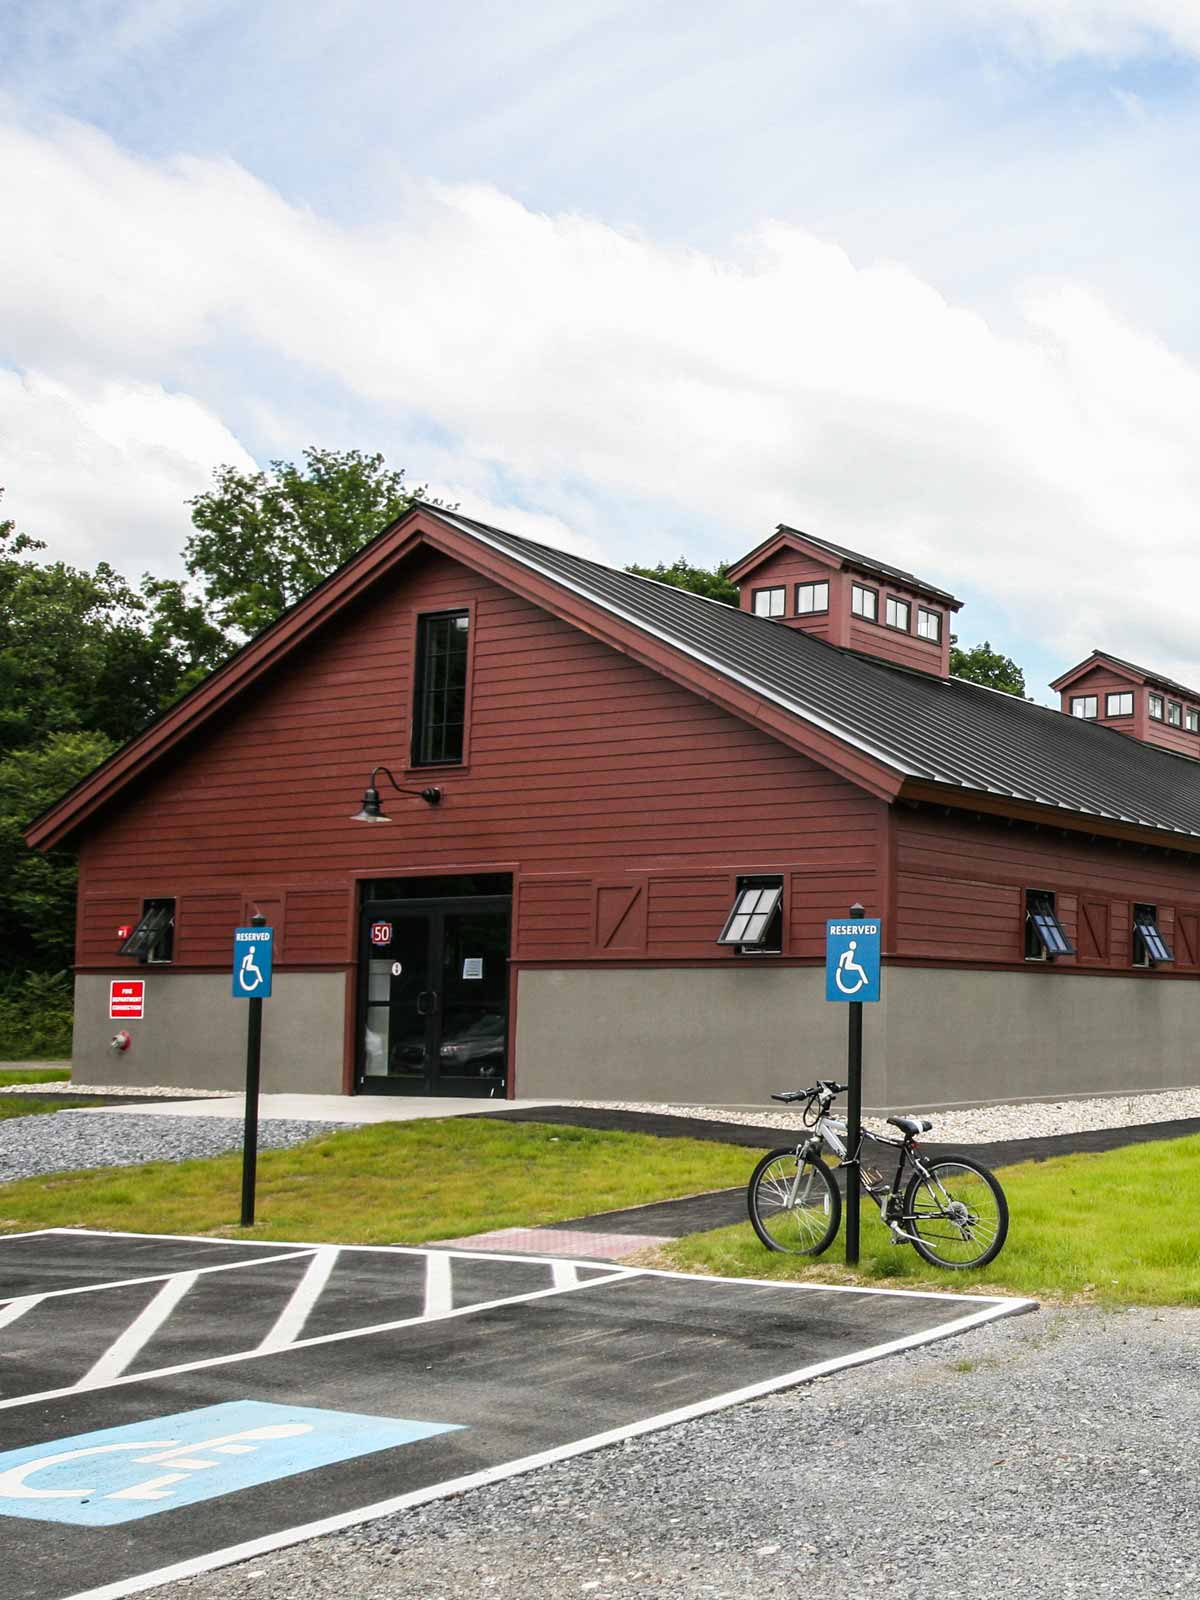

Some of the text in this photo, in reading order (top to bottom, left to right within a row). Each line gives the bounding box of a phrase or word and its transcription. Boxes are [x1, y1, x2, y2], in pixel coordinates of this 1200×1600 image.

[375, 927, 389, 941] 50
[830, 926, 877, 935] RESERVED
[236, 933, 270, 941] RESERVED
